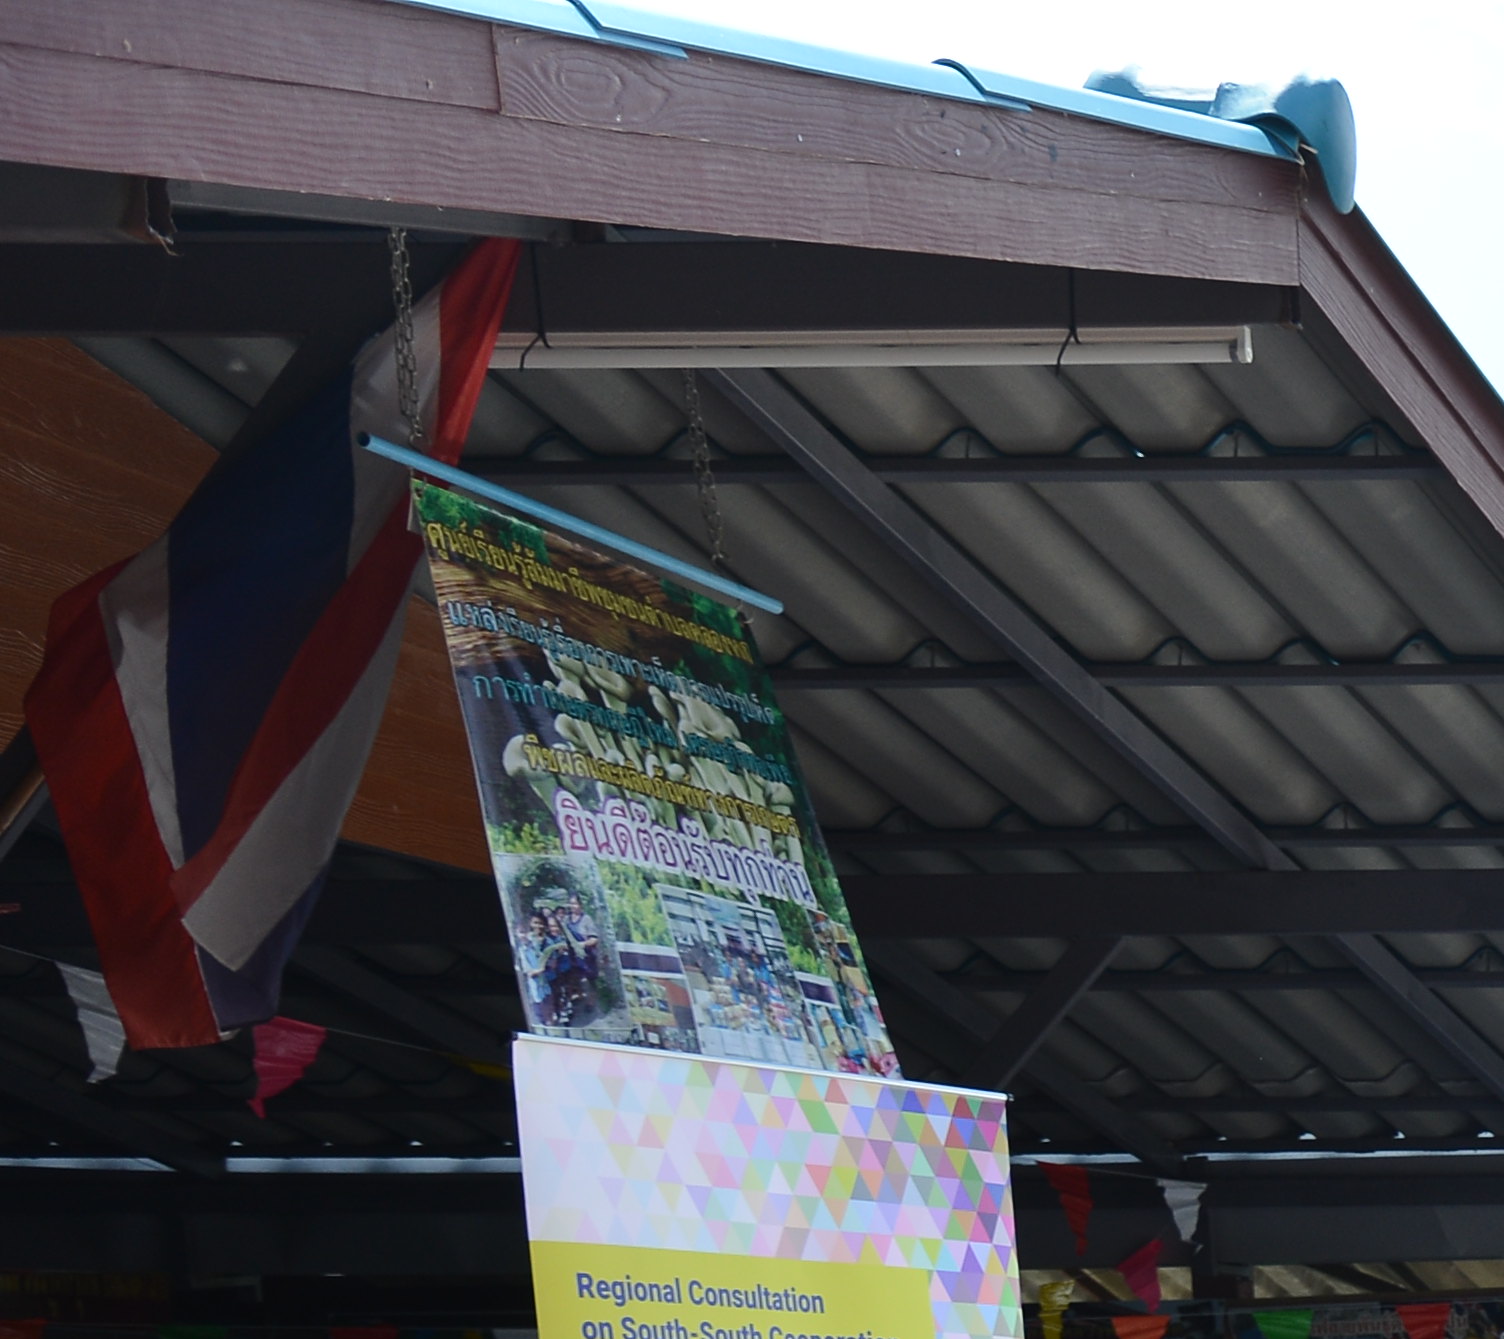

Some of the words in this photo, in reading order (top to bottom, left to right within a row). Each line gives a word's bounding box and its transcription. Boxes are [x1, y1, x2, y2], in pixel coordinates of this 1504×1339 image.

[558, 791, 816, 908] ยินดีต้อนรับทุกท่าน
[576, 1272, 682, 1307] Regional
[688, 1280, 825, 1314] Consultation
